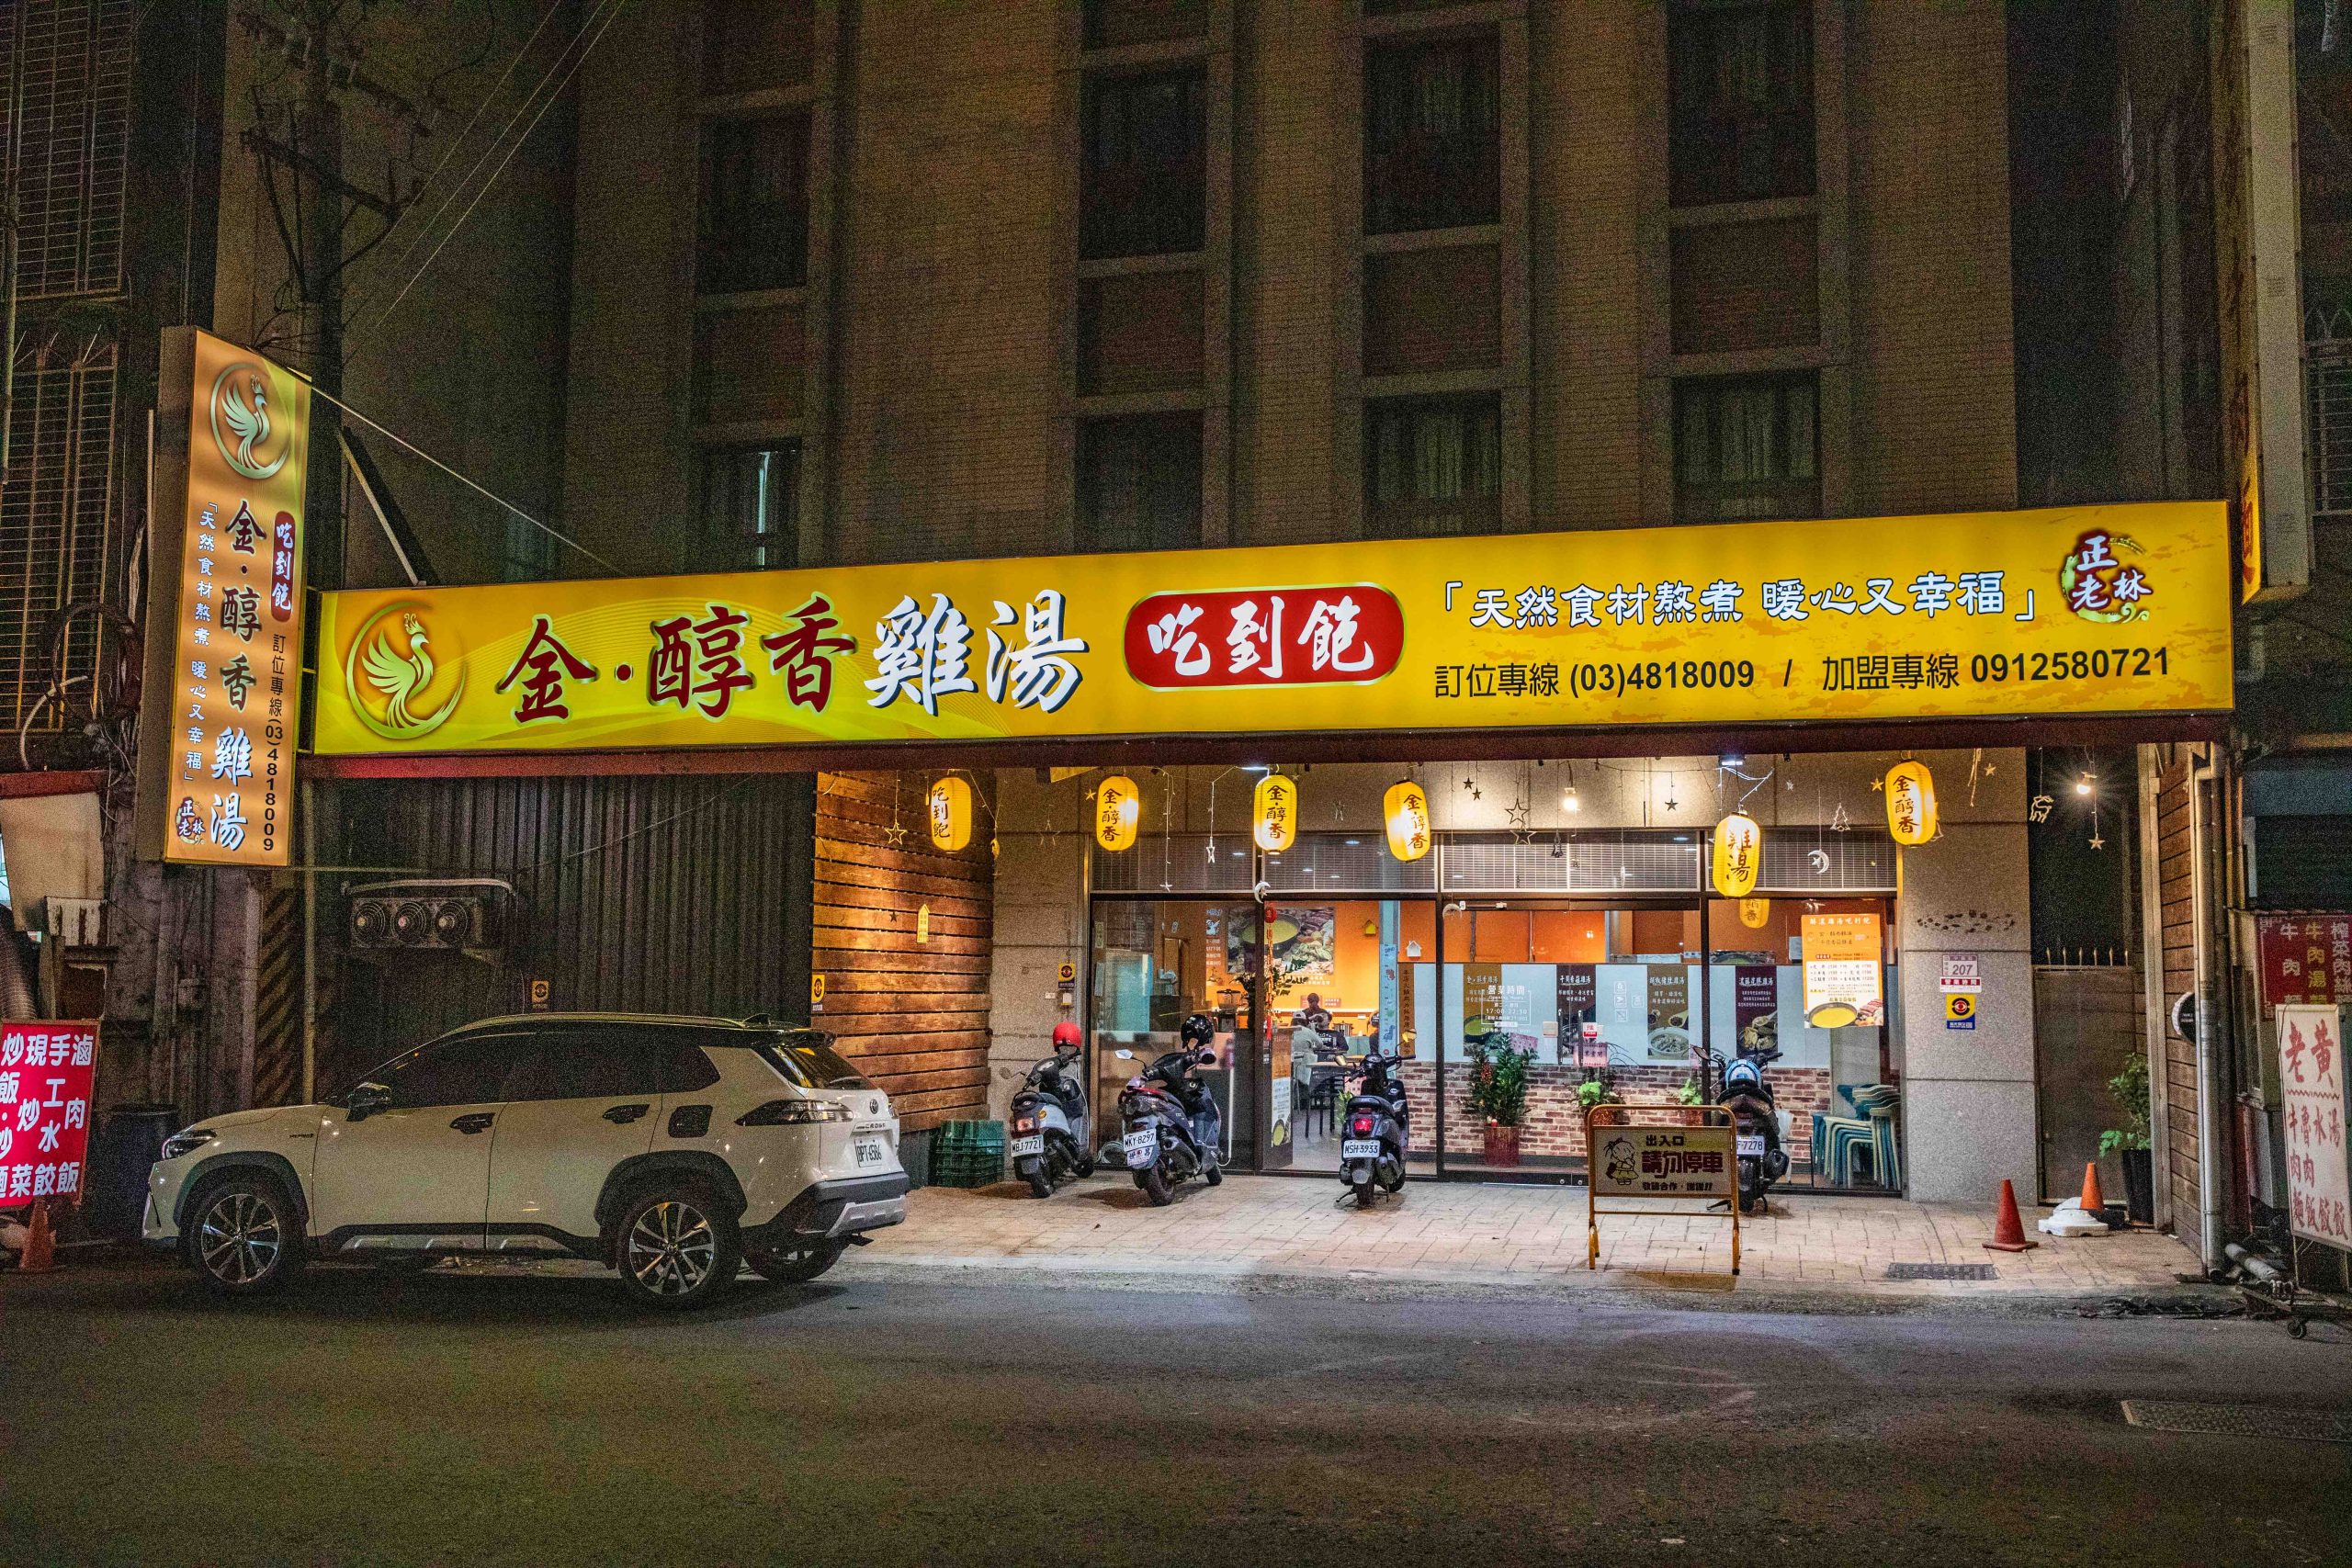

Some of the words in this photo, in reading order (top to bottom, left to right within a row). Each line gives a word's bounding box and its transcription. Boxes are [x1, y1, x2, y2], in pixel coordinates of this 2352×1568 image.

[273, 520, 294, 612] 吃到飽
[1148, 596, 1375, 679] 吃到飽
[1434, 662, 1560, 699] 訂位專線
[1569, 660, 1756, 698] (03)4818009
[1782, 659, 1792, 687] /
[1822, 654, 1960, 692] 加盟專線
[1971, 647, 2170, 683] 0912580721
[933, 785, 950, 839] 吃到飽
[1727, 829, 1752, 883] 雞湯
[1952, 964, 1973, 976] 207
[1012, 1139, 1042, 1154] MBJ-7721
[1125, 1133, 1155, 1148] MKY-8297
[1344, 1144, 1378, 1155] MSH-3933
[1645, 1134, 1685, 1147] 出入口
[1736, 1140, 1763, 1151] F-7278
[1641, 1150, 1724, 1179] 請勿停車
